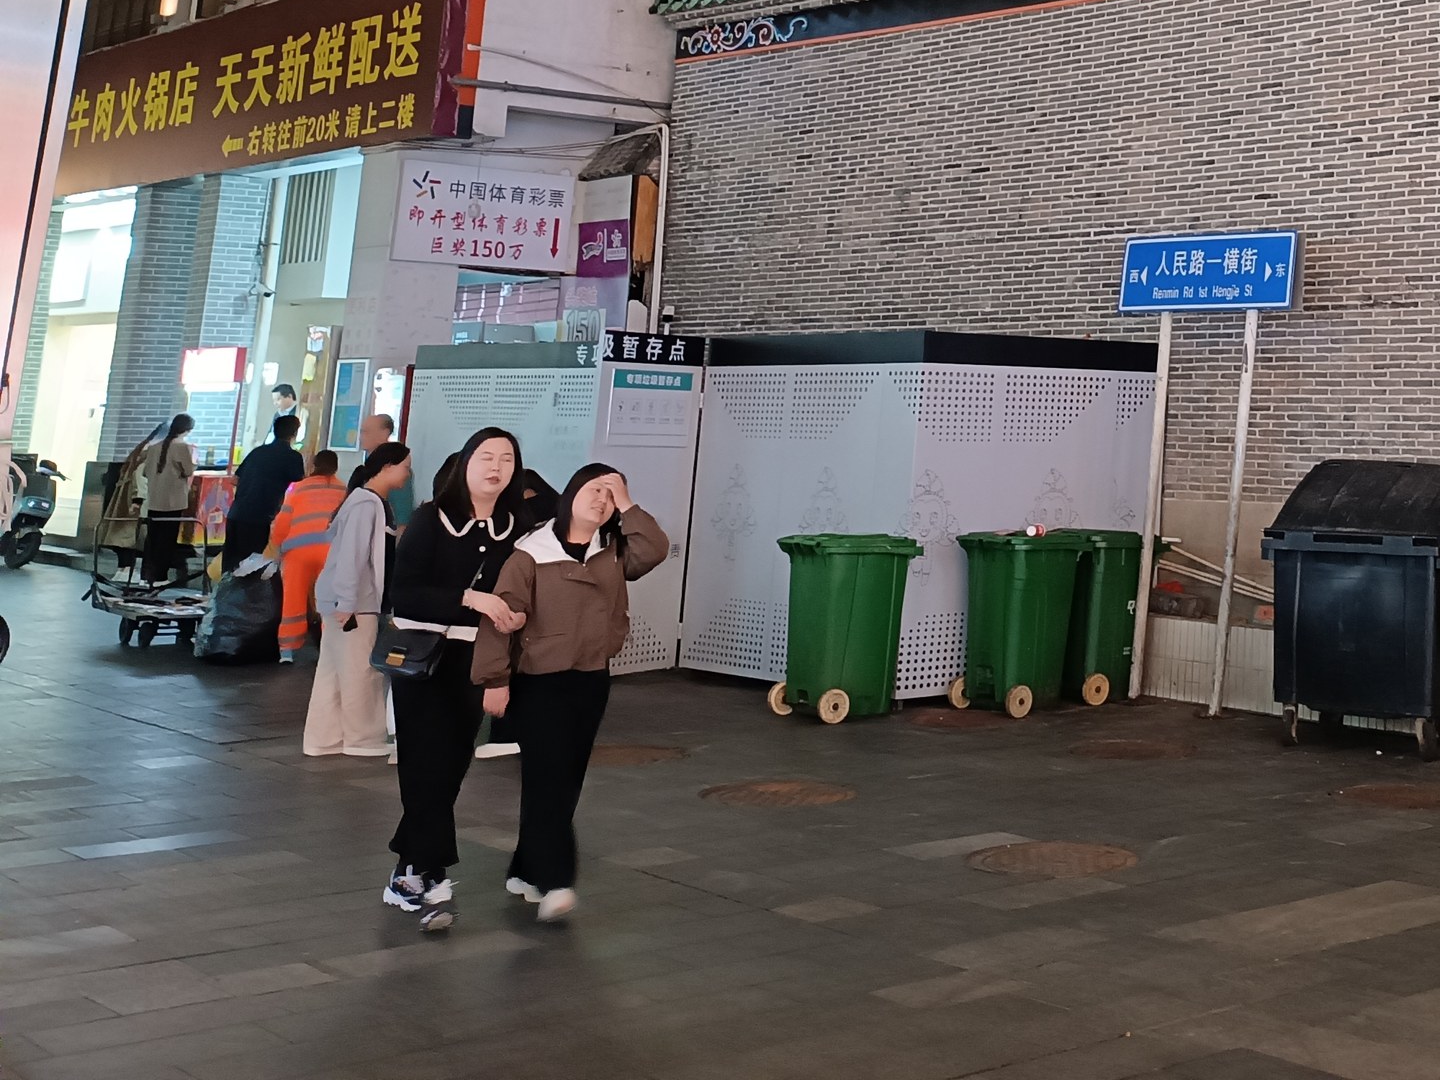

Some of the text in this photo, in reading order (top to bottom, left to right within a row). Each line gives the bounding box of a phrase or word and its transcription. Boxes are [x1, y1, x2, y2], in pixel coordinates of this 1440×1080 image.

[67, 1, 422, 148] 牛肉火锅店 天天新鲜配送
[247, 93, 416, 157] 右转往前20米 请上二楼
[449, 179, 566, 209] 中国体育彩票
[409, 205, 547, 238] 即开型体育彩票
[1129, 269, 1140, 284] 西
[1155, 247, 1258, 277] 人民路一横街
[1275, 262, 1287, 278] 东
[1152, 286, 1179, 300] Renmin
[1183, 285, 1194, 299] Rd
[1243, 283, 1253, 297] St
